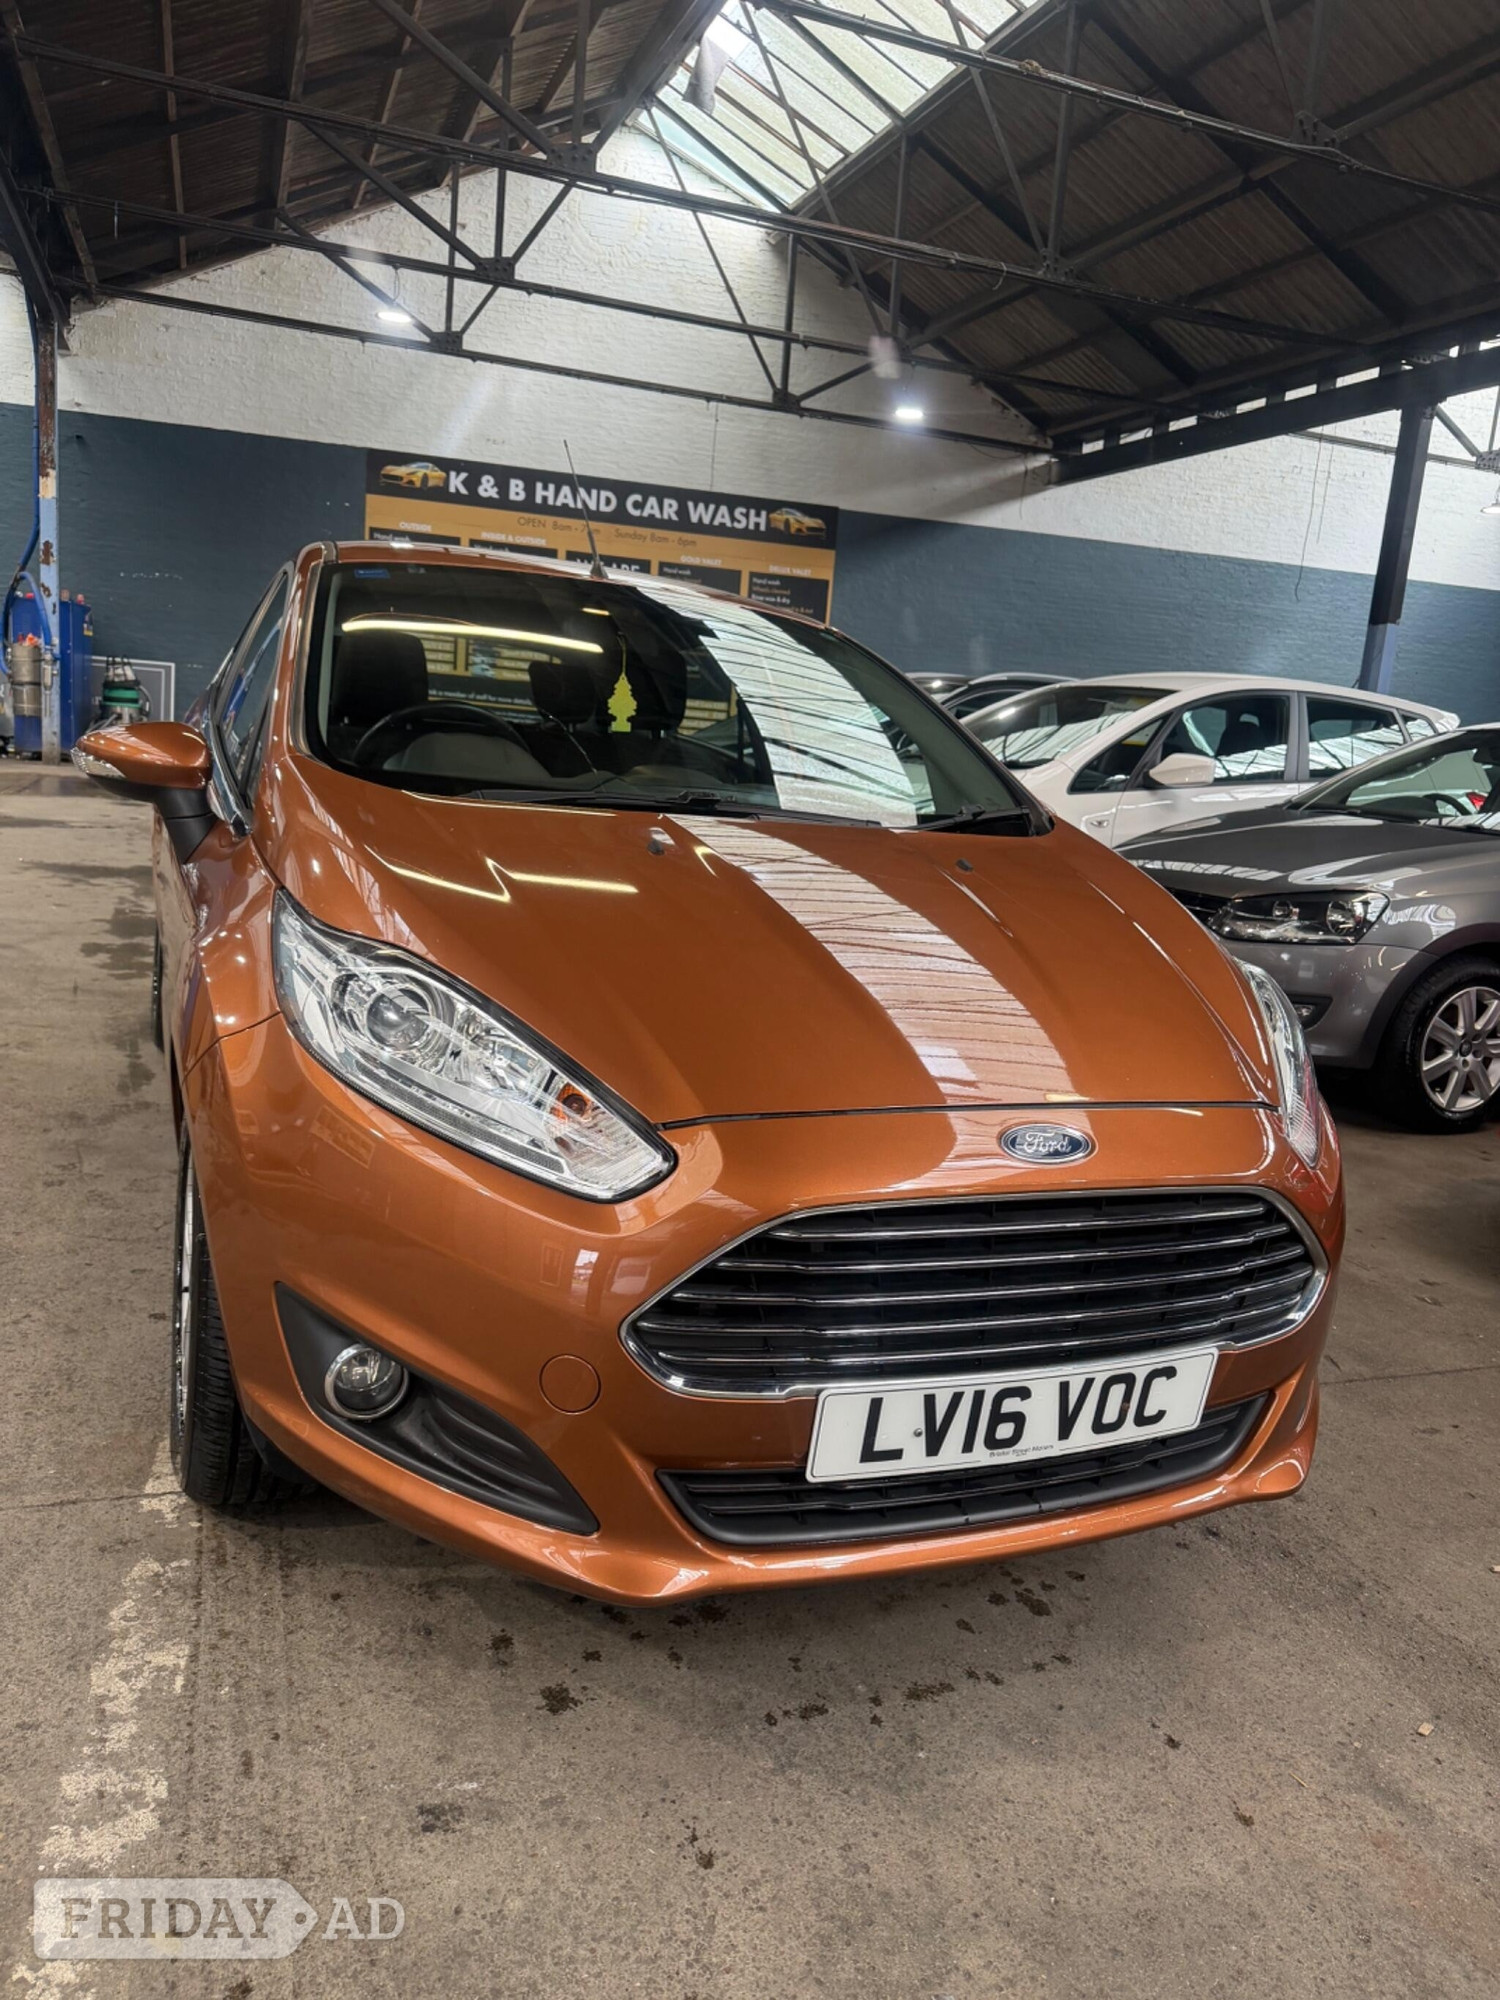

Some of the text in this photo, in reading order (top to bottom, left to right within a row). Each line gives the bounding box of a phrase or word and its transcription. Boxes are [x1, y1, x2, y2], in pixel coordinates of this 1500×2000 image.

[448, 470, 768, 532] K & B HAND CAR WASH
[399, 521, 433, 533] OUTSIDE
[480, 531, 506, 543] INSIDE
[515, 536, 547, 546] OUTSIDE
[517, 516, 547, 528] OPEN
[552, 520, 573, 532] 8am
[614, 528, 647, 543] Sunday
[650, 532, 670, 544] 8am
[677, 535, 698, 548] 6pm
[1015, 1130, 1072, 1154] Ford
[858, 1366, 1178, 1463] LV16 VOC
